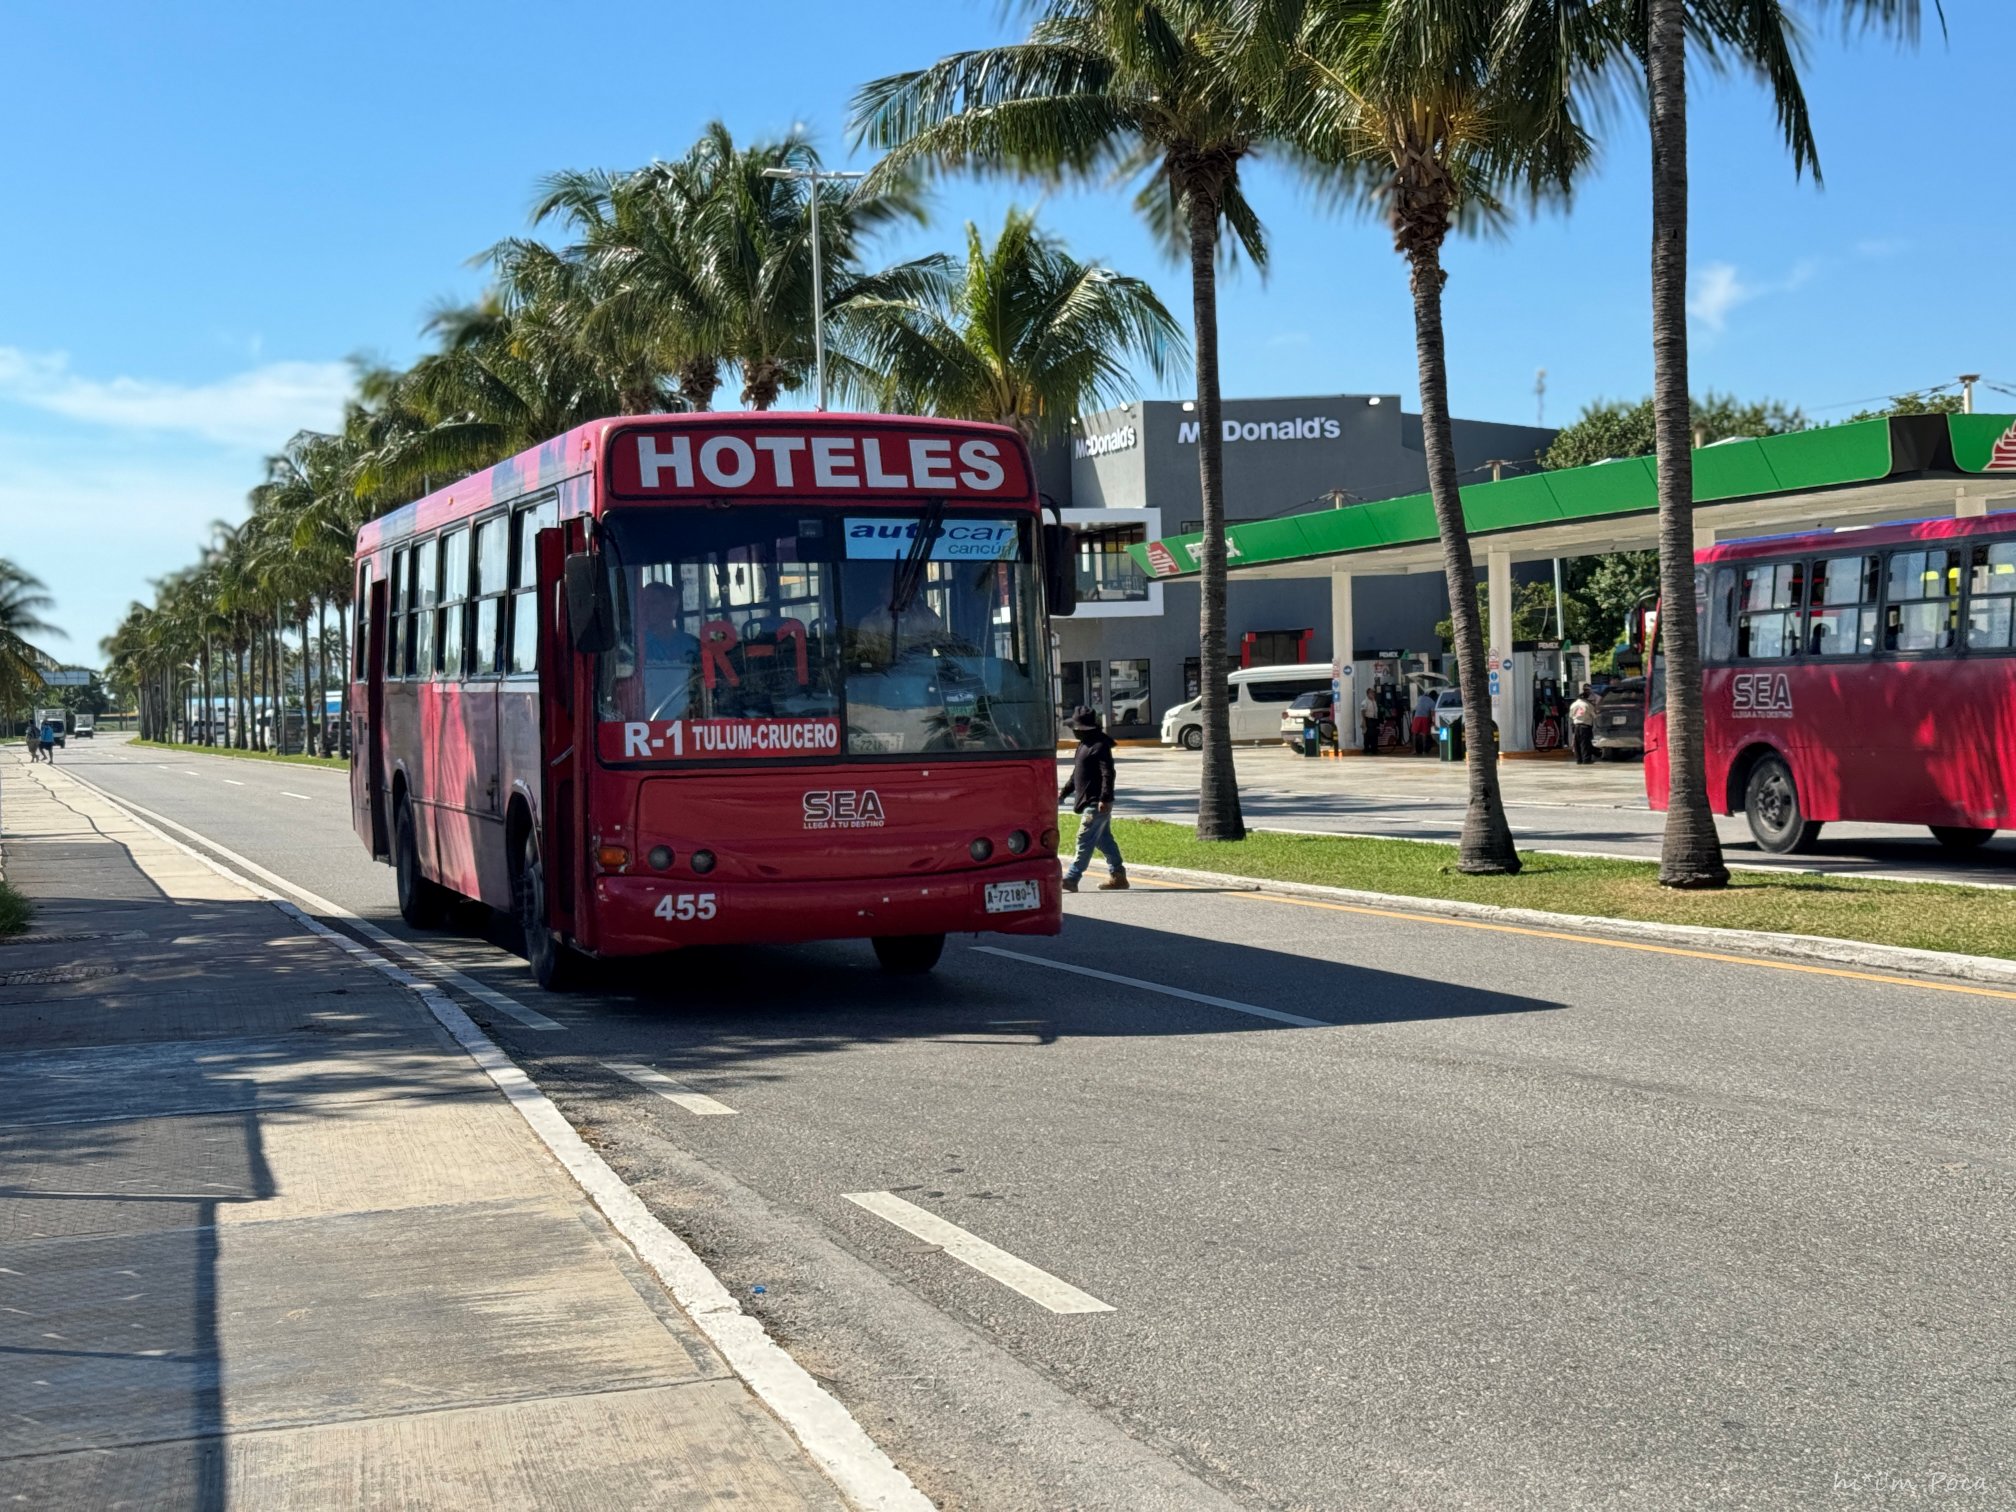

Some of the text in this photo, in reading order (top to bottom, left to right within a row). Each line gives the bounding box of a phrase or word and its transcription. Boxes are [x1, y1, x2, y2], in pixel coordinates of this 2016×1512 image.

[1075, 425, 1136, 459] McDonald's
[1178, 417, 1342, 443] MDonald's
[638, 436, 1005, 491] HOTELES
[948, 541, 1012, 555] cancún
[700, 620, 809, 689] R-1
[1732, 673, 1793, 709] SEA
[624, 720, 838, 757] R-1 TULUM-CRUCERO
[803, 790, 885, 821] SEA
[803, 820, 885, 830] LLEGA A TU DESTINO
[654, 893, 717, 921] 455
